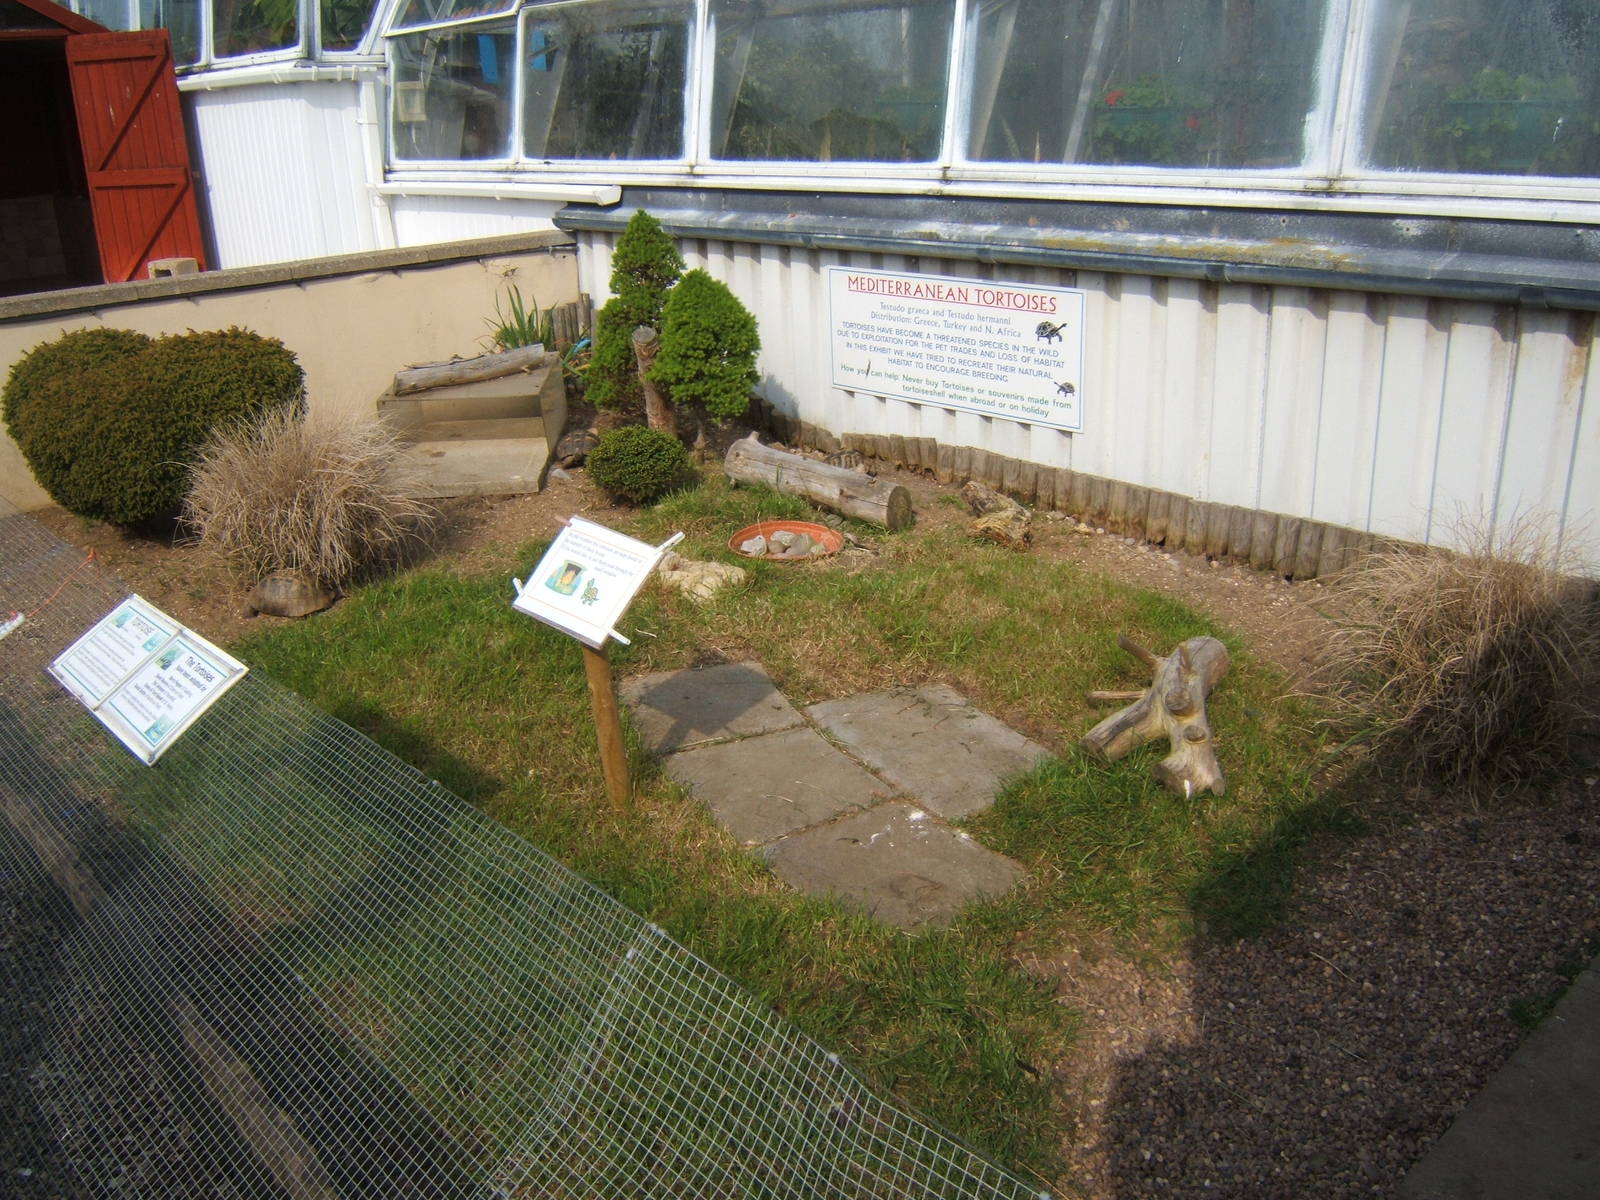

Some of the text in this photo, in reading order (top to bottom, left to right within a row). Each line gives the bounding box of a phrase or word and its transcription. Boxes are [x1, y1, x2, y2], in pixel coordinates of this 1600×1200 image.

[848, 276, 1056, 312] MEDITERRANEAN TORTOISES
[880, 302, 1011, 325] Testudo graeca and Testudo hermanni
[914, 317, 940, 328] Greece,
[944, 320, 966, 332] Turkey
[997, 327, 1022, 338] Africa
[842, 322, 875, 332] TORTOISES
[877, 325, 894, 334] HAVE
[896, 328, 924, 339] BECOME
[934, 334, 976, 346] THREATENED
[979, 340, 1009, 351] SPECIES
[1039, 348, 1059, 357] WILD
[861, 332, 904, 345] EXPLOITATION
[905, 340, 918, 348] FOR
[922, 341, 934, 349] THE
[936, 343, 947, 351] PET
[950, 346, 977, 356] TRADES
[980, 350, 996, 358] AND
[1034, 358, 1064, 368] HABITAT
[869, 345, 891, 354] EXHIBIT
[907, 351, 922, 359] HAVE
[926, 353, 944, 362] TRIED
[958, 359, 993, 370] RECREATE
[997, 364, 1016, 373] THEIR
[1019, 368, 1053, 379] NATURAL
[888, 357, 913, 367] HABITAT
[926, 363, 972, 376] ENCOURAGE
[972, 370, 1008, 382] BREEDING
[841, 363, 855, 372] How
[902, 374, 922, 384] Never
[926, 378, 938, 388] buy
[942, 380, 974, 393] Tortoises
[988, 390, 1024, 401] souvenirs
[1028, 396, 1049, 405] made
[1052, 398, 1072, 409] from
[902, 384, 945, 397] tortoiseshell
[948, 392, 967, 401] when
[970, 396, 995, 407] abroad
[1022, 405, 1049, 418] holiday
